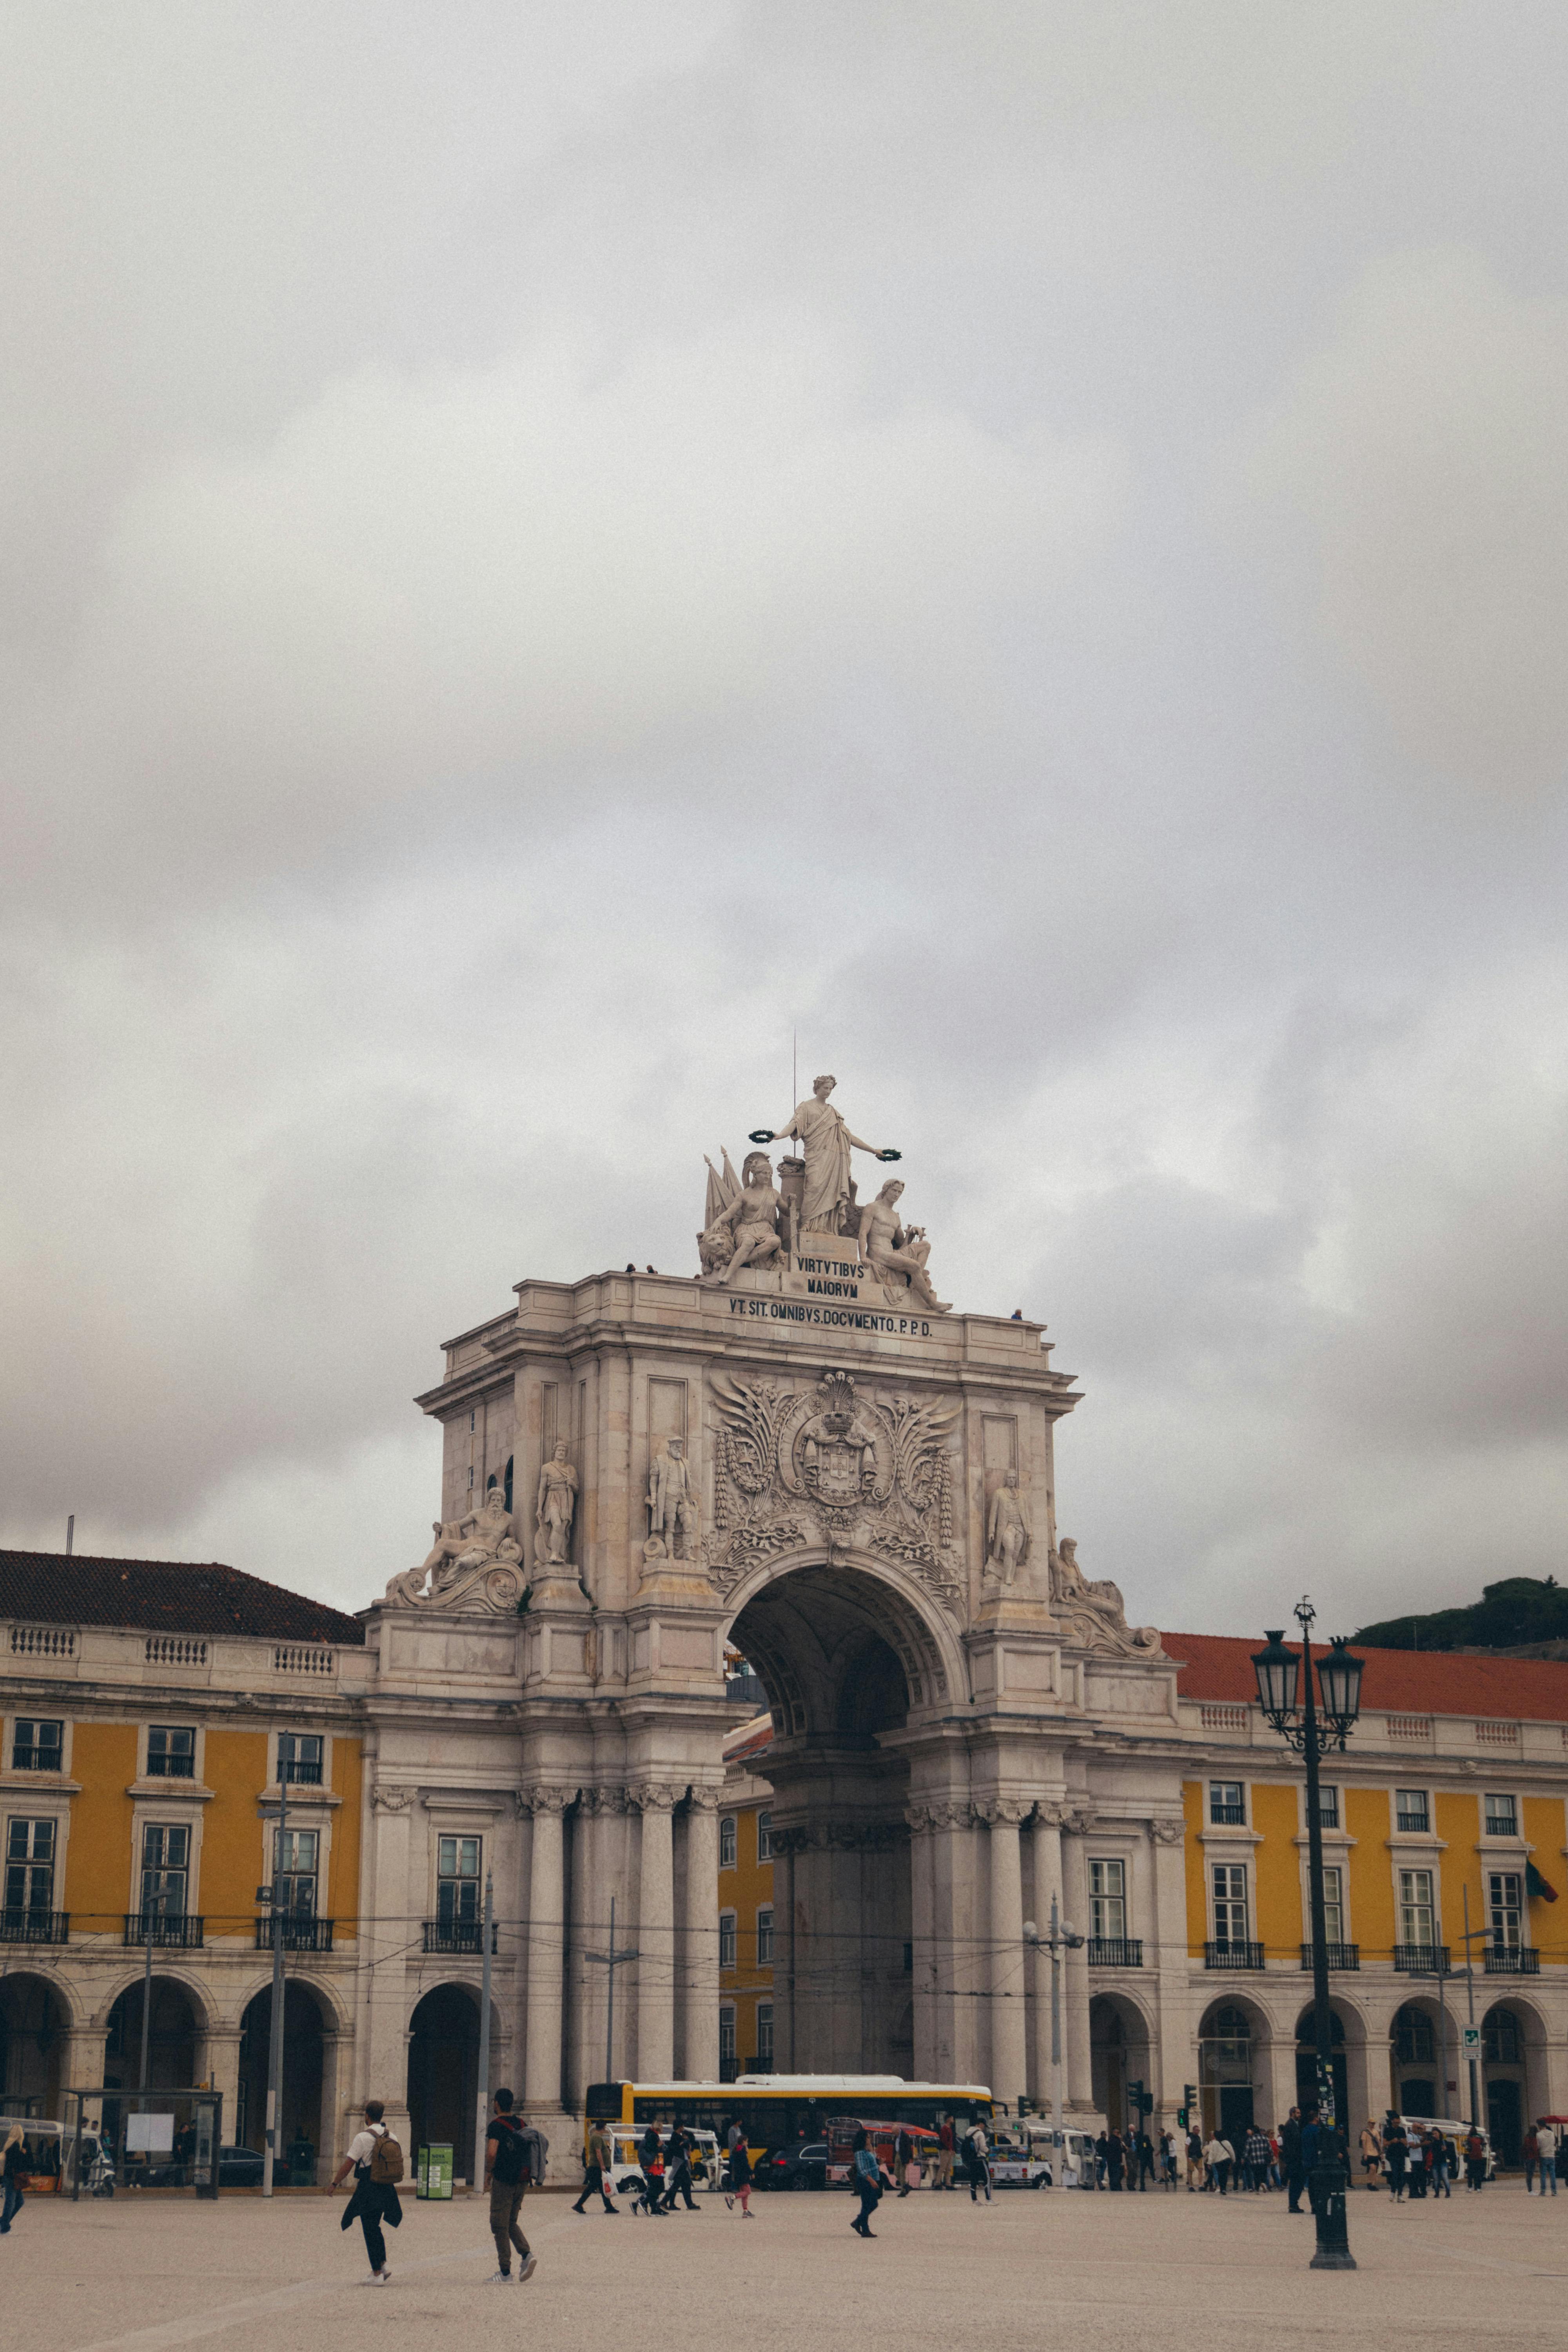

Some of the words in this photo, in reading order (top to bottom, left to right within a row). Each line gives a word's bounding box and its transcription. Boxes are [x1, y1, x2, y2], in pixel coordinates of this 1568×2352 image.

[797, 1257, 864, 1278] VIRTVTIBVS
[808, 1279, 858, 1298] MAIORVM
[730, 1299, 746, 1314] VT.
[749, 1301, 768, 1317] SIT.
